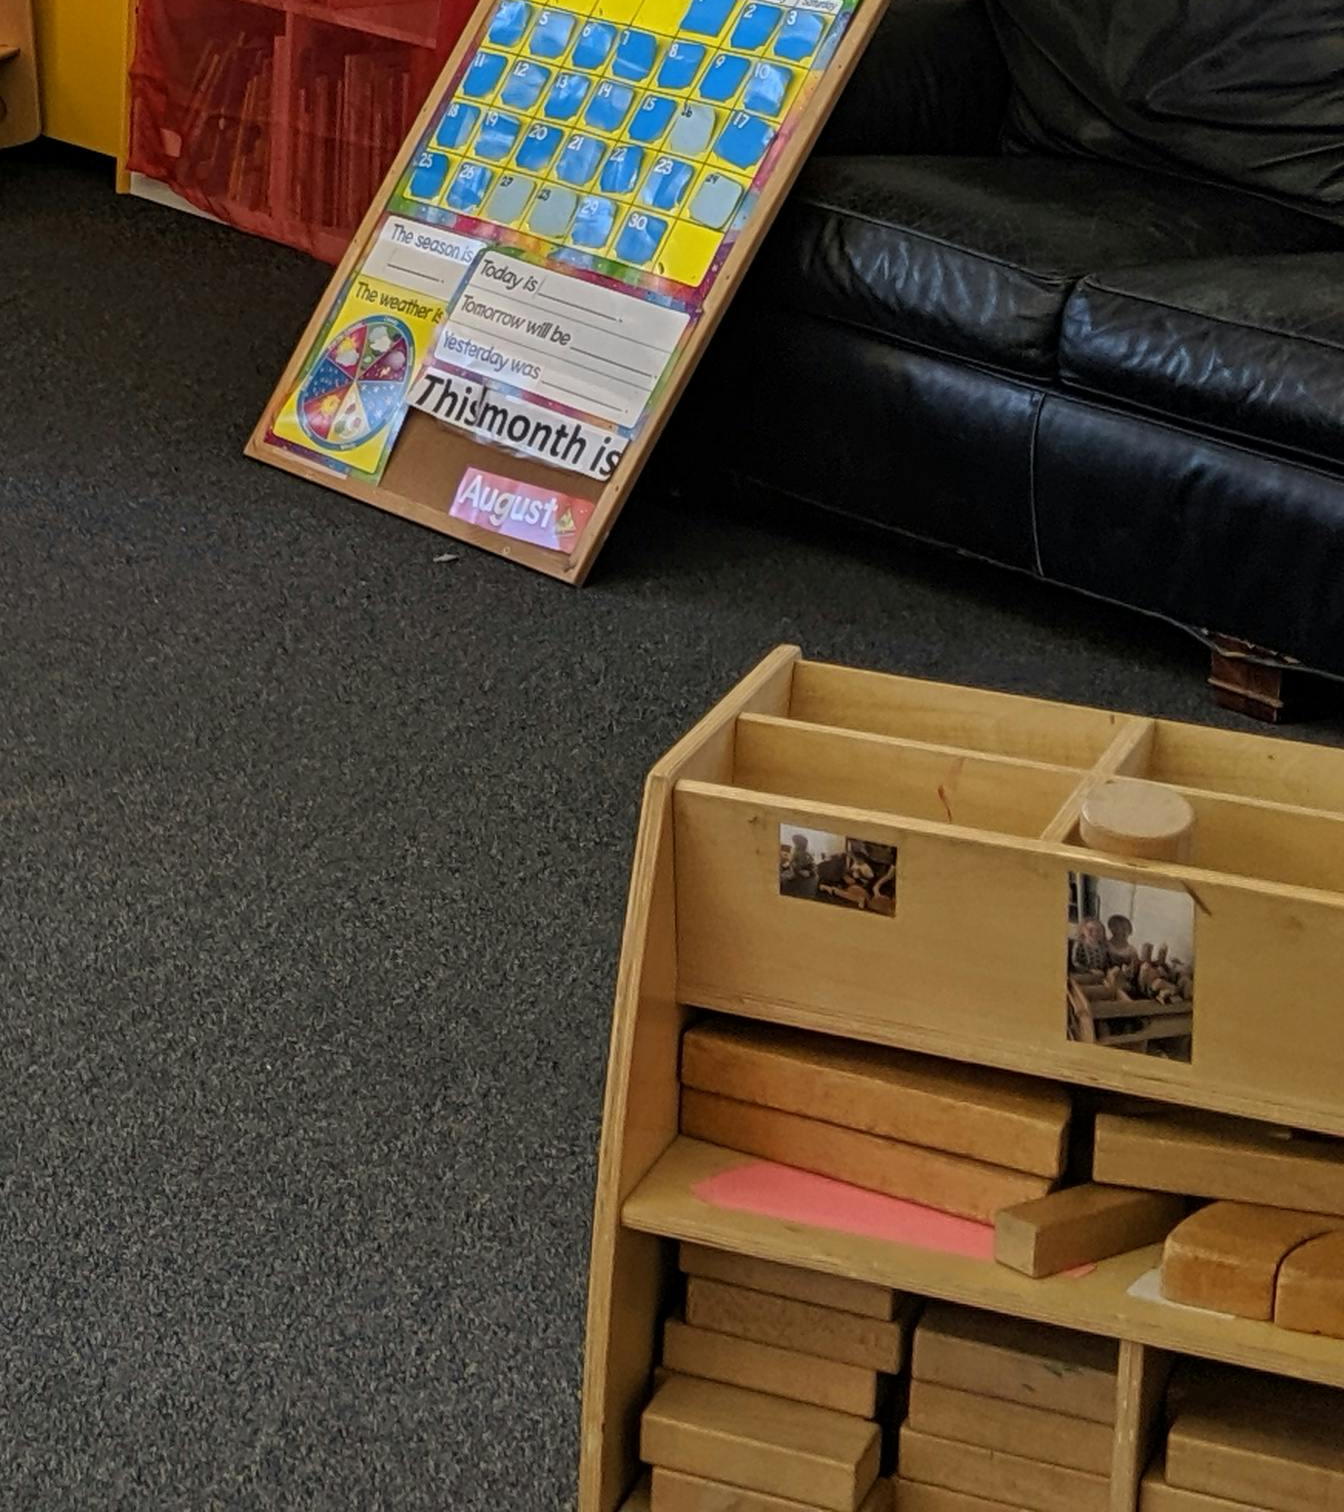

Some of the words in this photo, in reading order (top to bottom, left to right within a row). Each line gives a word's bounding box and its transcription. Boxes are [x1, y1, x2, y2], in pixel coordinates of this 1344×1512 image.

[743, 3, 757, 19] 2
[787, 10, 797, 25] 3
[539, 10, 549, 25] 5
[582, 23, 591, 37] 6
[622, 30, 632, 45] 7
[669, 43, 679, 58] 8
[715, 54, 725, 68] 9
[755, 64, 769, 79] 10
[474, 53, 486, 67] 11
[513, 62, 529, 77] 12
[556, 74, 568, 88] 13
[598, 83, 612, 97] 14
[642, 97, 657, 111] 15
[733, 112, 750, 128] 17
[446, 102, 460, 117] 18
[485, 112, 499, 127] 19
[529, 123, 548, 139] 20
[567, 135, 583, 150] 21
[610, 147, 627, 162] 22
[654, 159, 673, 175] 23
[418, 153, 433, 168] 25
[459, 164, 474, 179] 26
[581, 200, 598, 215] 29
[628, 213, 648, 230] 30
[392, 223, 413, 245] The
[415, 235, 459, 261] season
[461, 246, 474, 264] is
[480, 259, 523, 290] Today
[523, 275, 539, 292] is
[356, 281, 375, 303] The
[379, 292, 432, 319] weather
[431, 307, 444, 324] is
[461, 294, 526, 330] Tomorrow
[526, 319, 553, 339] will
[550, 326, 572, 346] be
[443, 331, 509, 372] Yesterday
[511, 359, 542, 379] was
[415, 374, 480, 427] This
[476, 400, 587, 465] month
[589, 435, 624, 477] is
[459, 475, 559, 528] August
